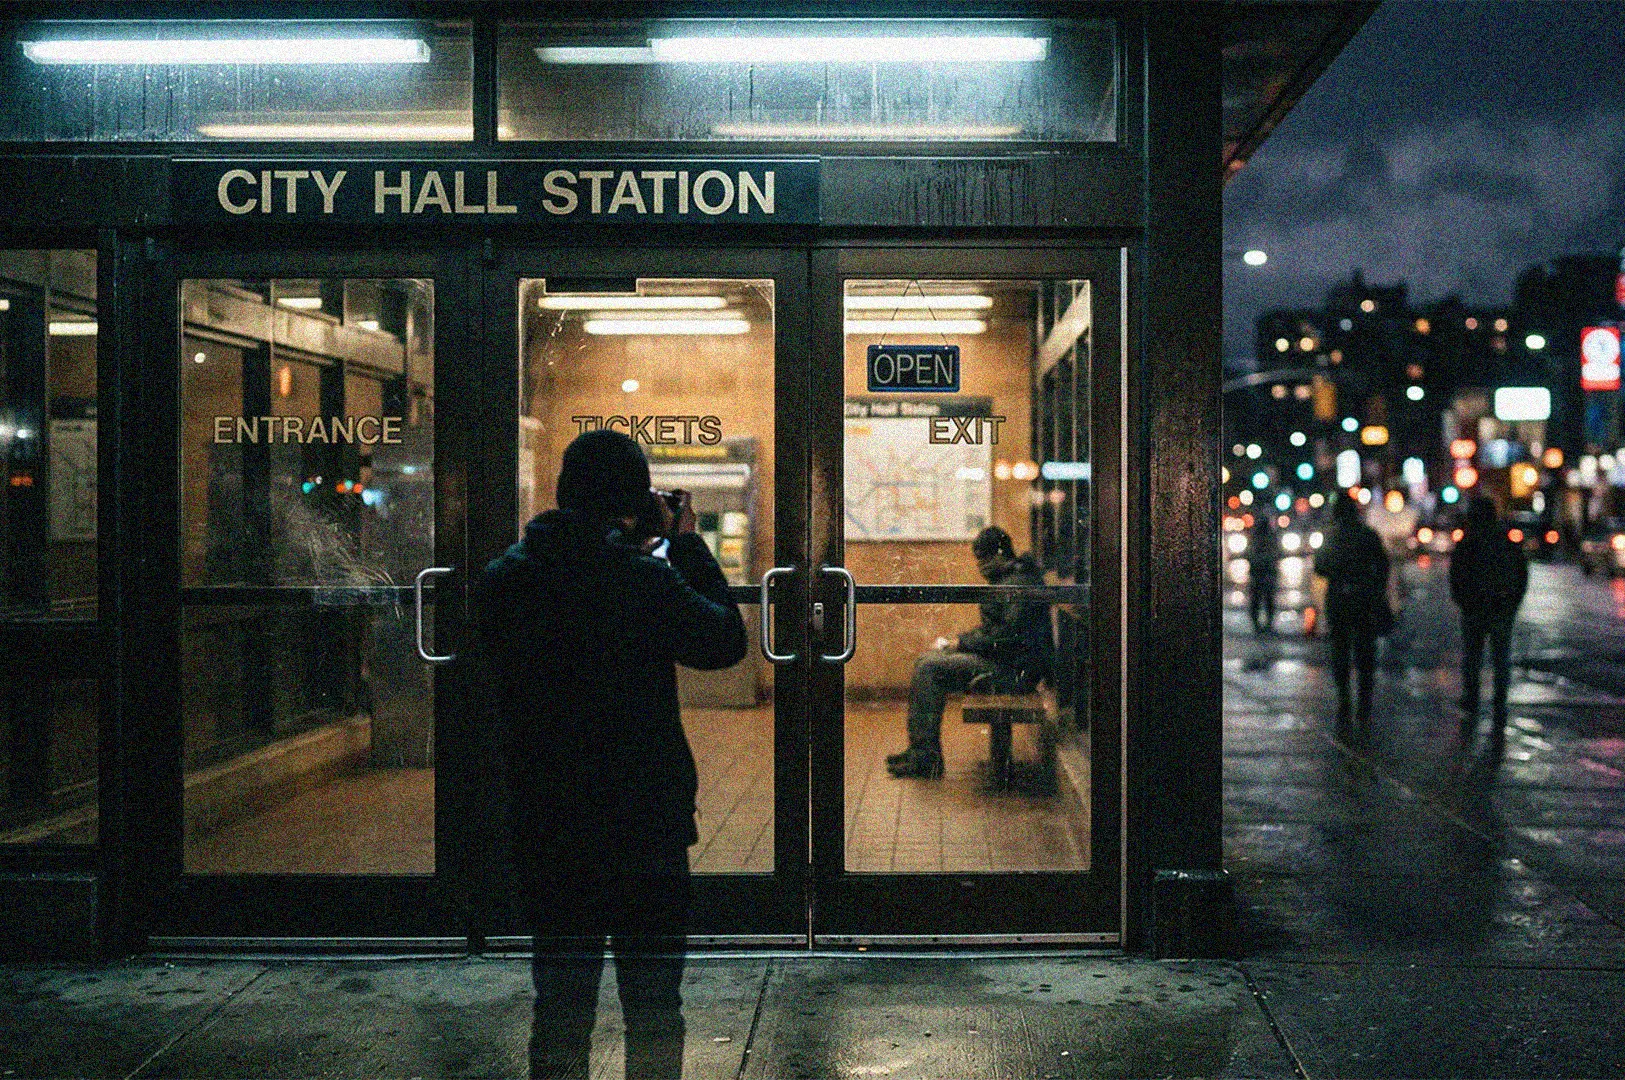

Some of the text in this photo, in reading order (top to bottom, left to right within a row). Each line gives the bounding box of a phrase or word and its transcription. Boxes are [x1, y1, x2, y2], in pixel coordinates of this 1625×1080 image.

[217, 169, 776, 215] CITY HALL STATION
[873, 353, 954, 385] OPEN
[213, 415, 403, 445] ENTRANCE
[928, 416, 1006, 445] EXIT
